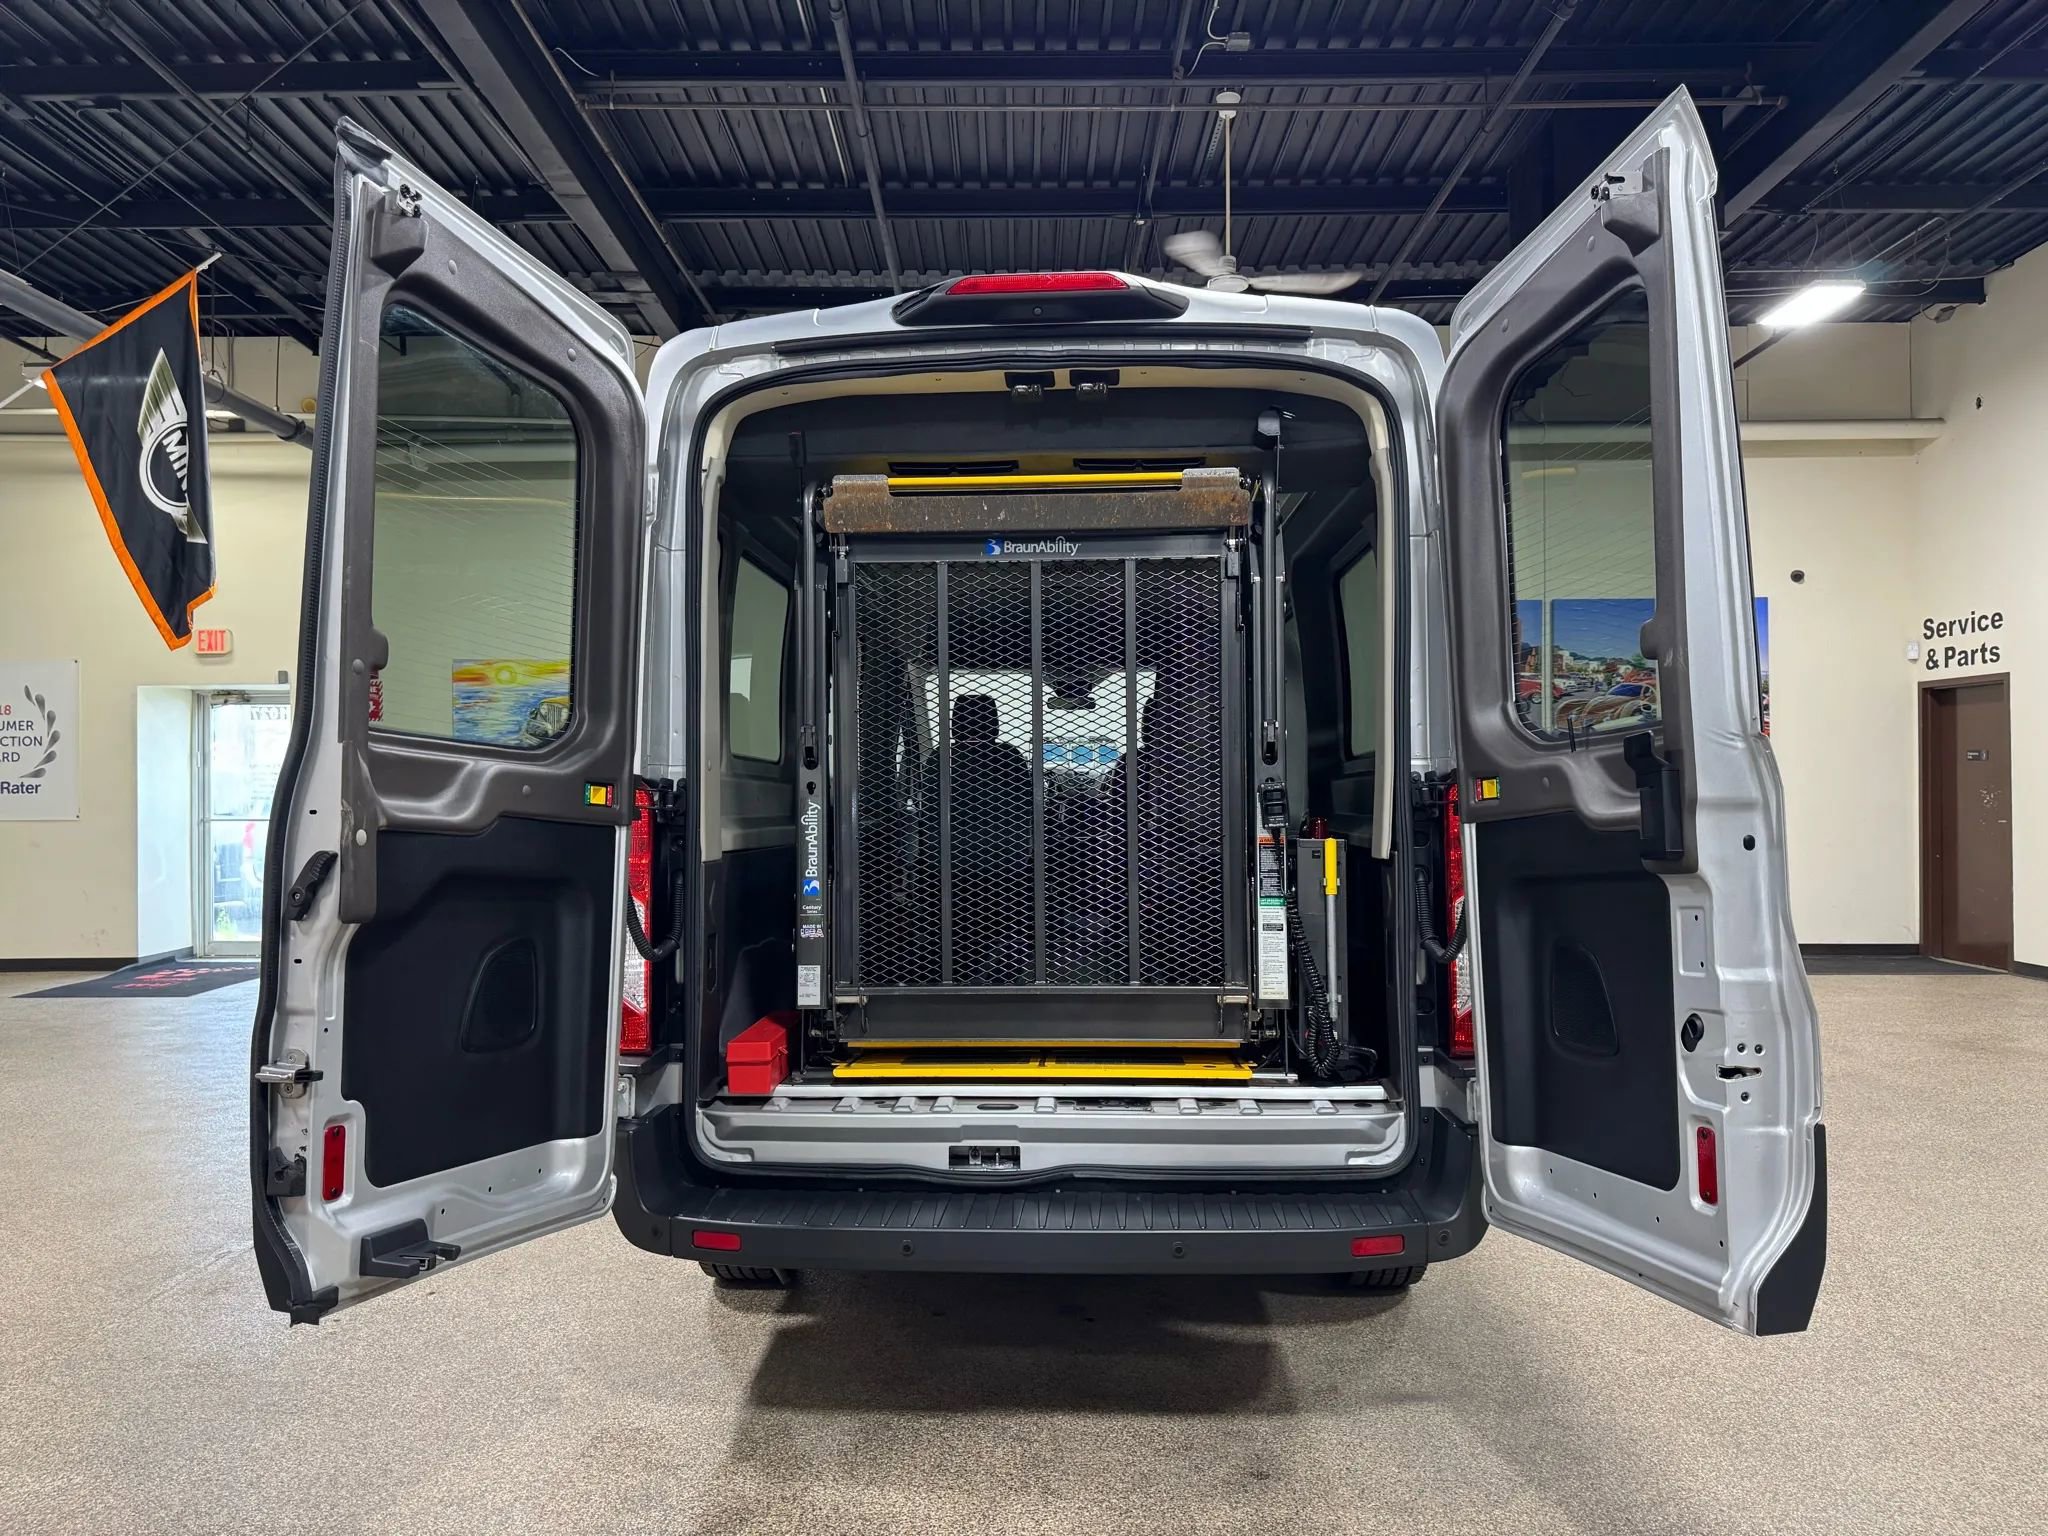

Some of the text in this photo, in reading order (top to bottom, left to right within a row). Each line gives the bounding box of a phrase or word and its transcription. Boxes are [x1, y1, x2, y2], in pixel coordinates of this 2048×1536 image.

[1004, 536, 1079, 556] BraunAbility
[1923, 611, 2004, 640] Service
[198, 630, 226, 652] EXIT
[1926, 642, 2001, 670] & Parts
[0, 751, 21, 762] RD
[0, 781, 41, 795] Rater
[801, 801, 821, 877] BraunAbility
